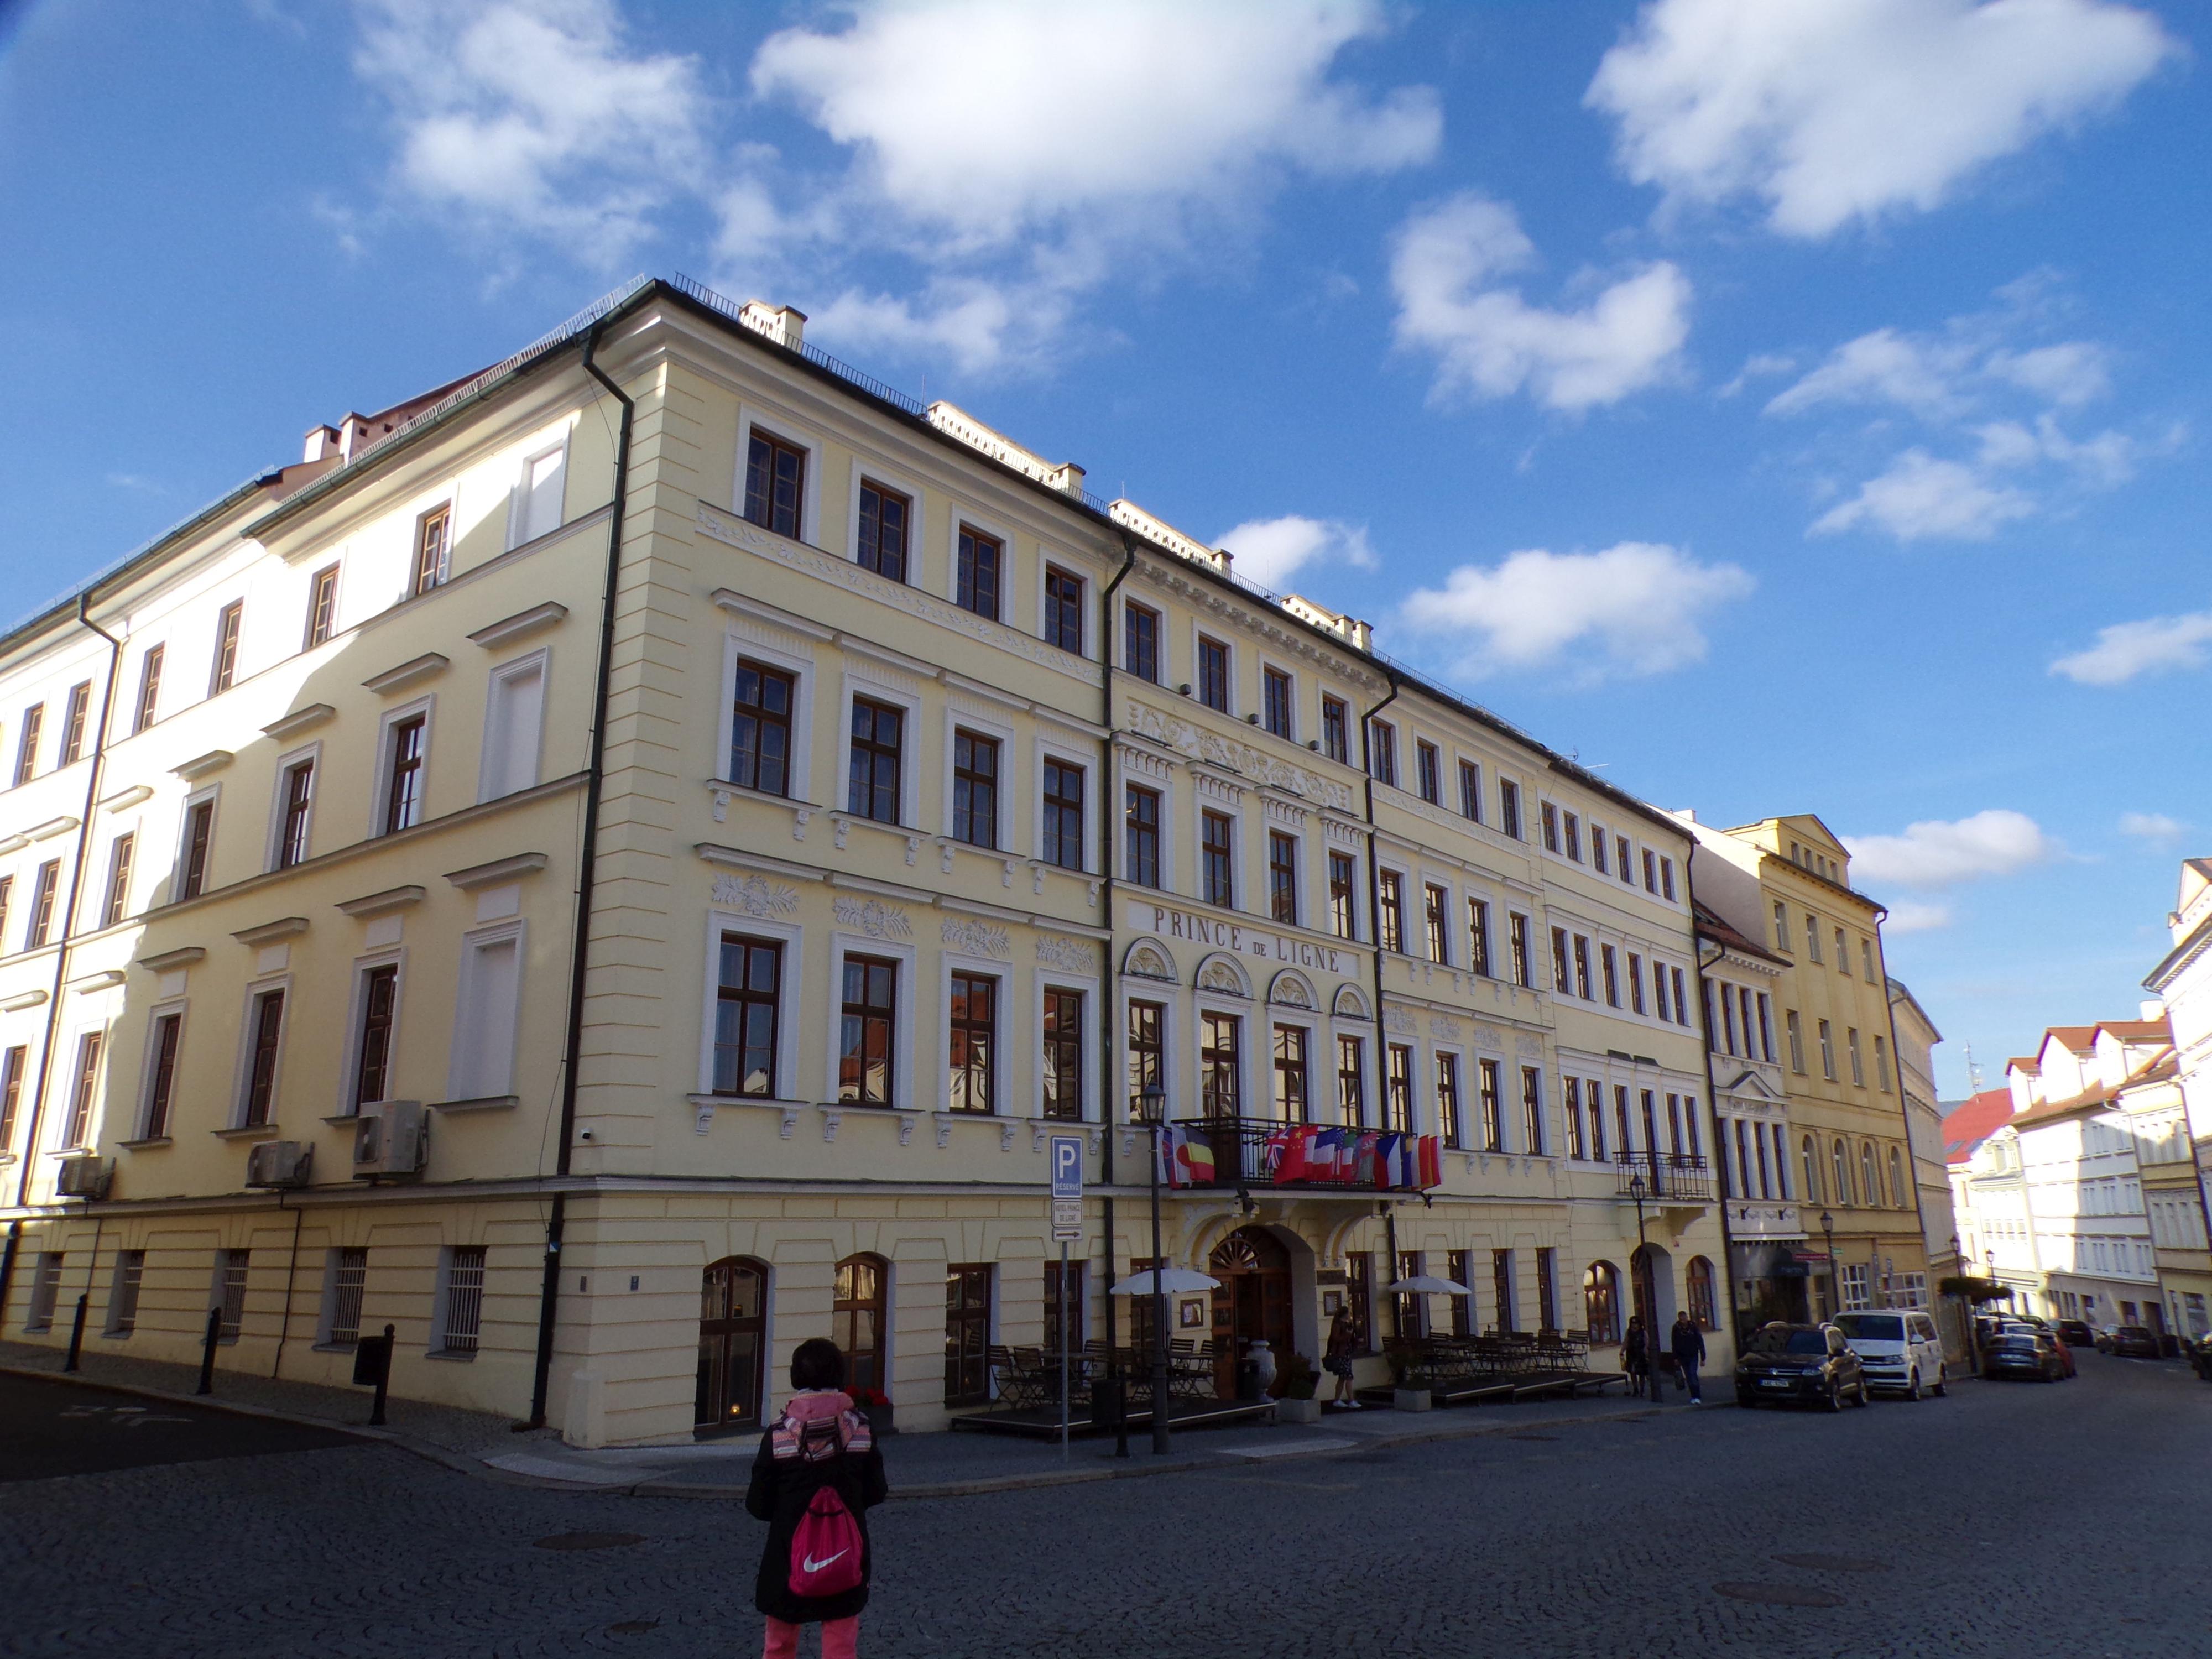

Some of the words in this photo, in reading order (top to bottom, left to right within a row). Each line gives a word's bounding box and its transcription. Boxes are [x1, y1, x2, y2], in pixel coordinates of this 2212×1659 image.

[1154, 906, 1242, 951] PRINCE
[1253, 941, 1266, 956] DE
[1277, 937, 1339, 972] LIGNE
[1058, 1145, 1076, 1178] P
